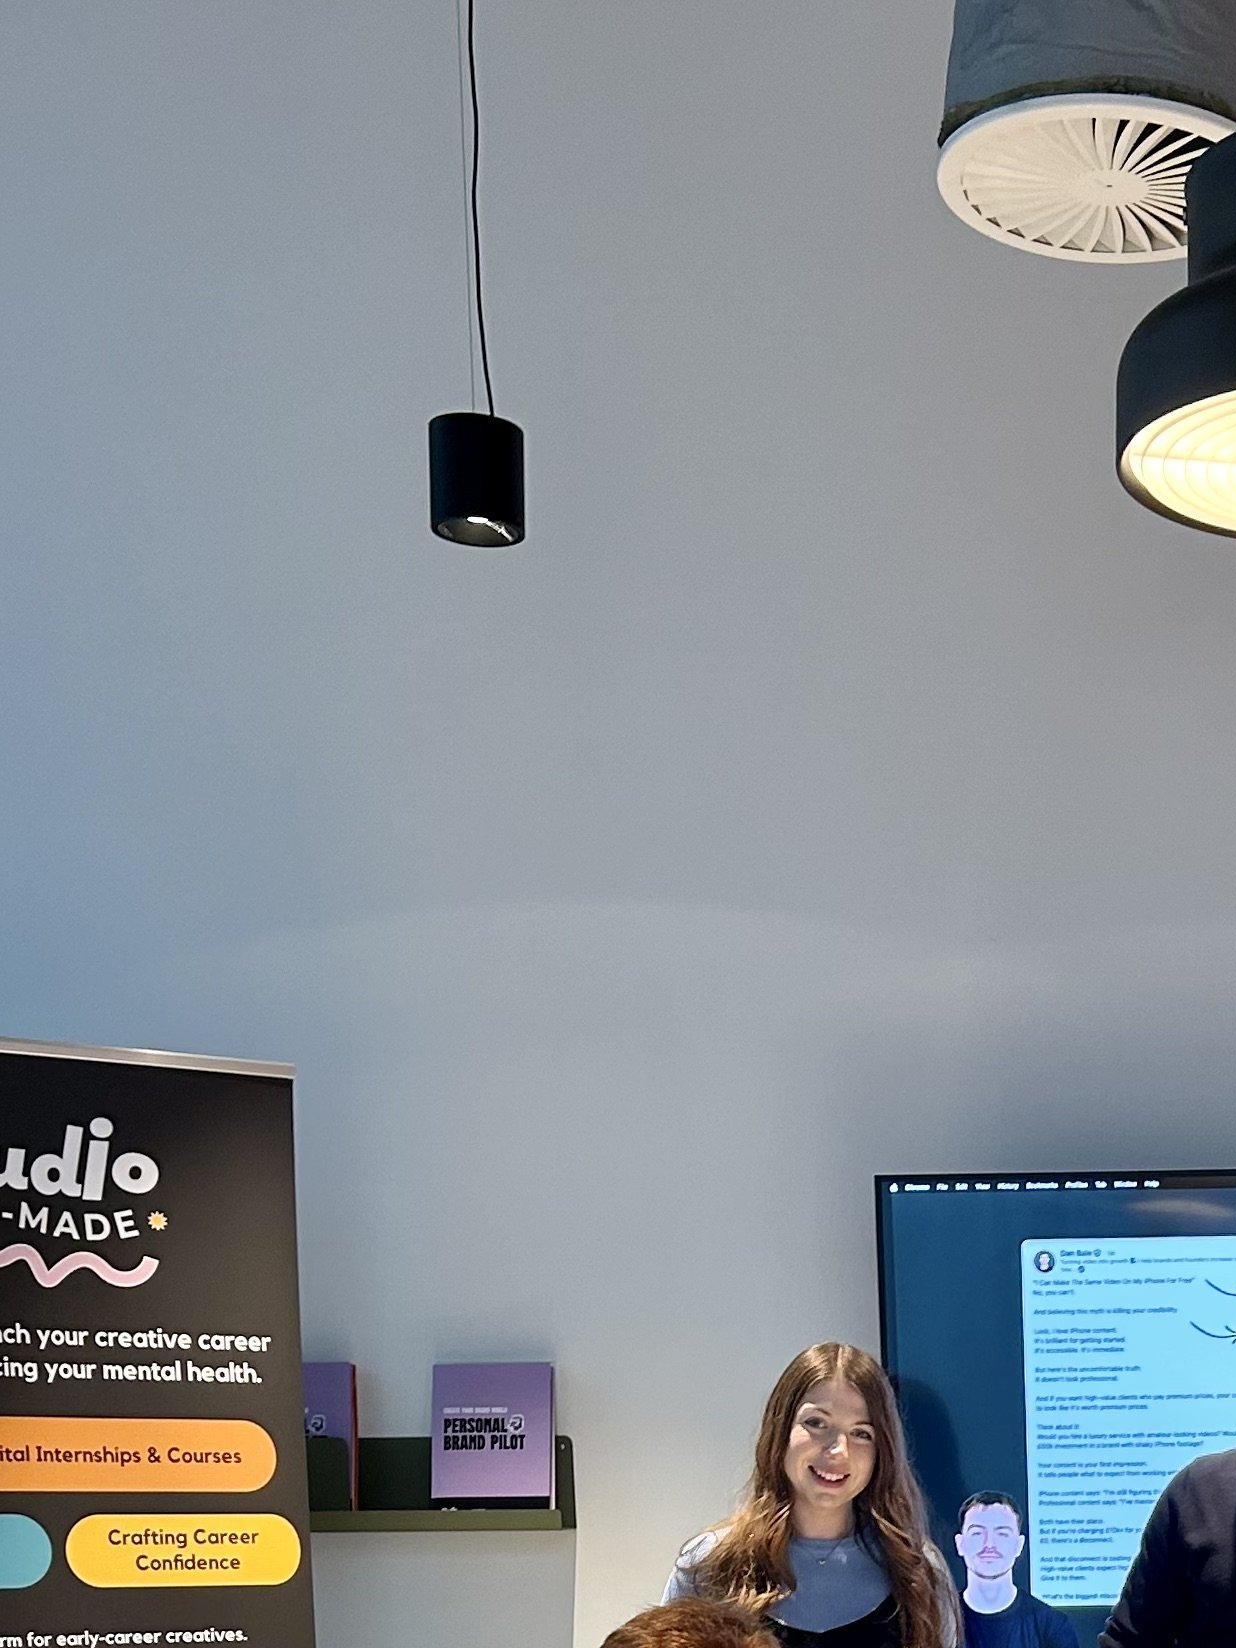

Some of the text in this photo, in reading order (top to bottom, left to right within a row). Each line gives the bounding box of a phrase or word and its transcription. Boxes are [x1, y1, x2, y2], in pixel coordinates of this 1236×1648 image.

[0, 1117, 159, 1201] udio
[1, 1201, 140, 1241] -MADE
[36, 1328, 89, 1350] your
[95, 1327, 193, 1350] creative
[198, 1331, 272, 1352] career
[44, 1360, 97, 1383] your
[103, 1359, 182, 1382] mental
[187, 1361, 262, 1384] health.
[443, 1417, 508, 1434] PERSONAL
[443, 1434, 526, 1451] BRAND PILOT
[0, 1445, 242, 1467] ital Internships & Courses
[108, 1529, 259, 1549] Crafting Career
[136, 1554, 241, 1571] Confidence
[26, 1631, 51, 1648] for
[56, 1629, 163, 1648] early-career
[165, 1628, 249, 1644] creatives.
